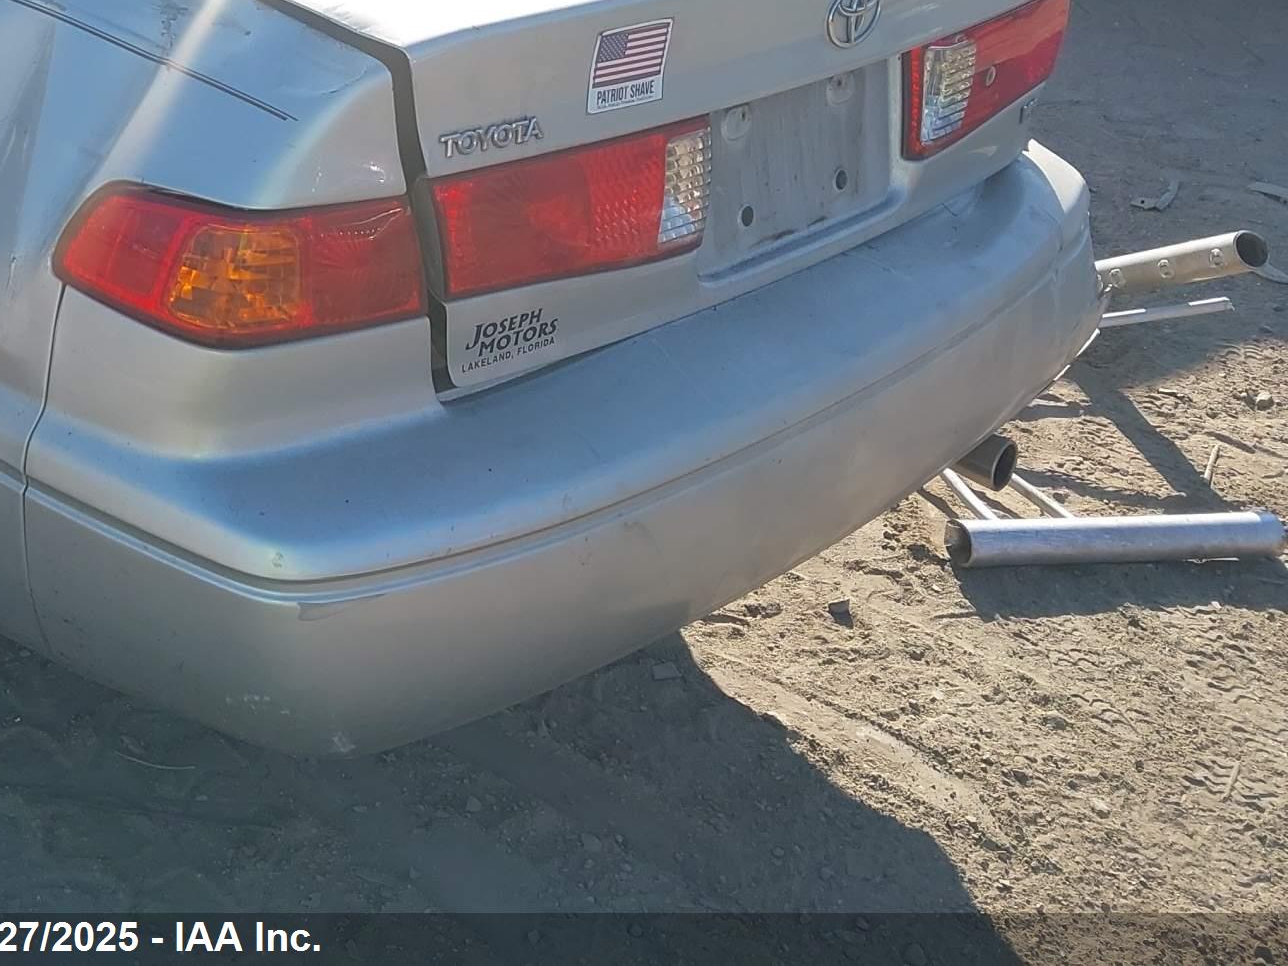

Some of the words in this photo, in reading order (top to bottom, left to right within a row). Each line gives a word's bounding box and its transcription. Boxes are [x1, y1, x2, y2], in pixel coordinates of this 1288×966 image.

[596, 85, 629, 106] PATRIOT
[630, 79, 655, 99] SHAVE
[439, 115, 544, 159] TOYOTA
[465, 308, 543, 351] JOSEPH
[478, 318, 559, 357] MOTORS
[461, 351, 515, 374] LAKELAND,
[516, 336, 555, 355] FLORIDA
